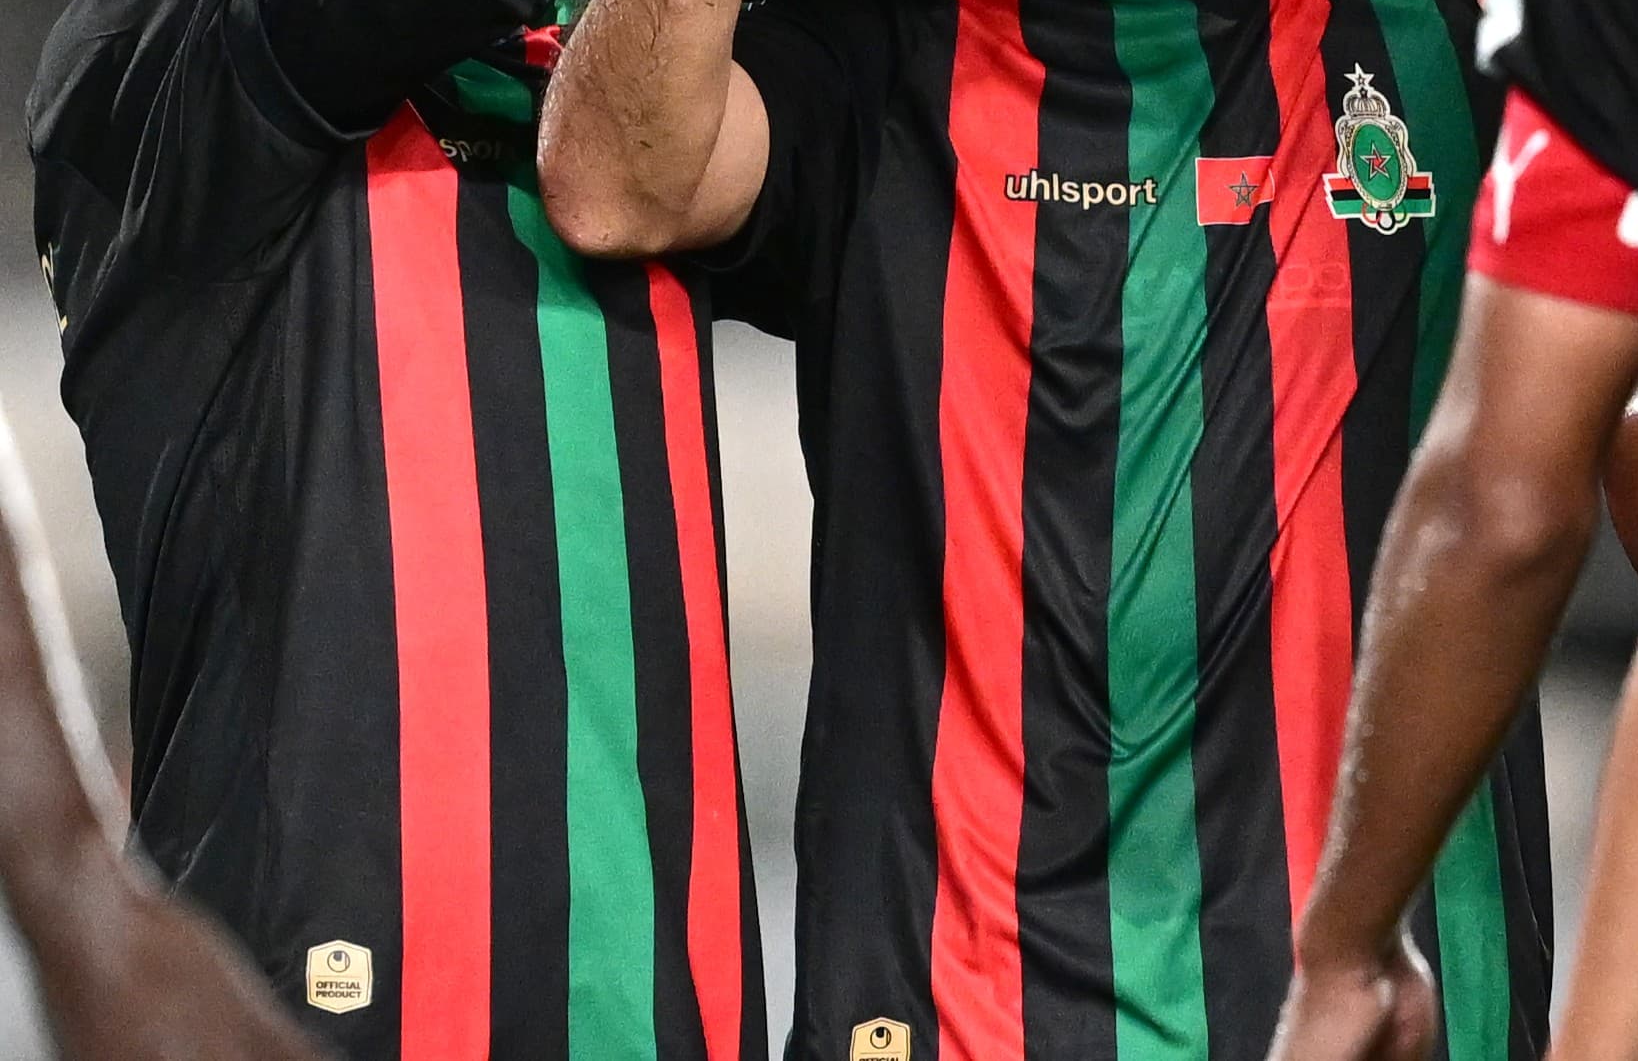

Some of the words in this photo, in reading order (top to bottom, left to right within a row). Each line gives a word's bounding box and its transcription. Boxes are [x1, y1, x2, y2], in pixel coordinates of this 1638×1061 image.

[1005, 169, 1158, 211] uhlsport
[315, 981, 361, 990] OFFICIAL
[315, 990, 361, 998] PRODUCT
